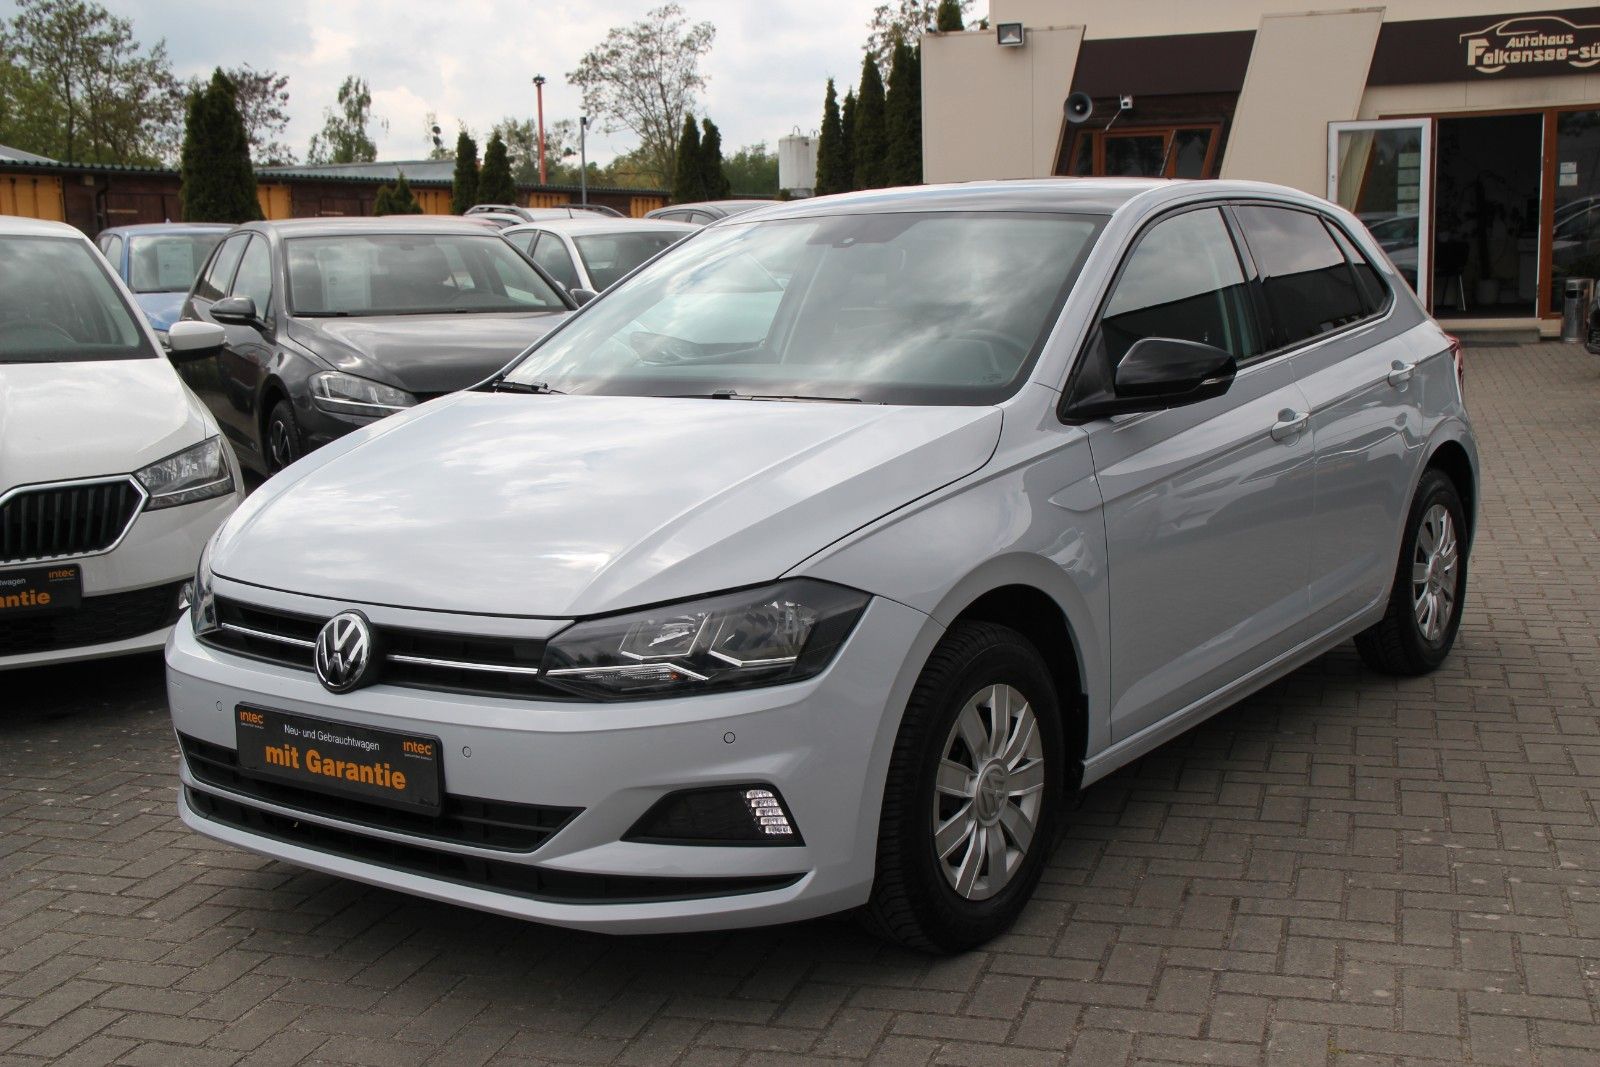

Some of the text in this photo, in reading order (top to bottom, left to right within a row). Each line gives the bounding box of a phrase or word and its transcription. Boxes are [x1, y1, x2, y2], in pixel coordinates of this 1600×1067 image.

[1505, 34, 1574, 48] Autohaus
[240, 711, 264, 725] intec
[284, 724, 380, 752] Neu- und Gebrauchtwagen
[403, 741, 432, 756] intec
[265, 743, 407, 790] mit Garantie
